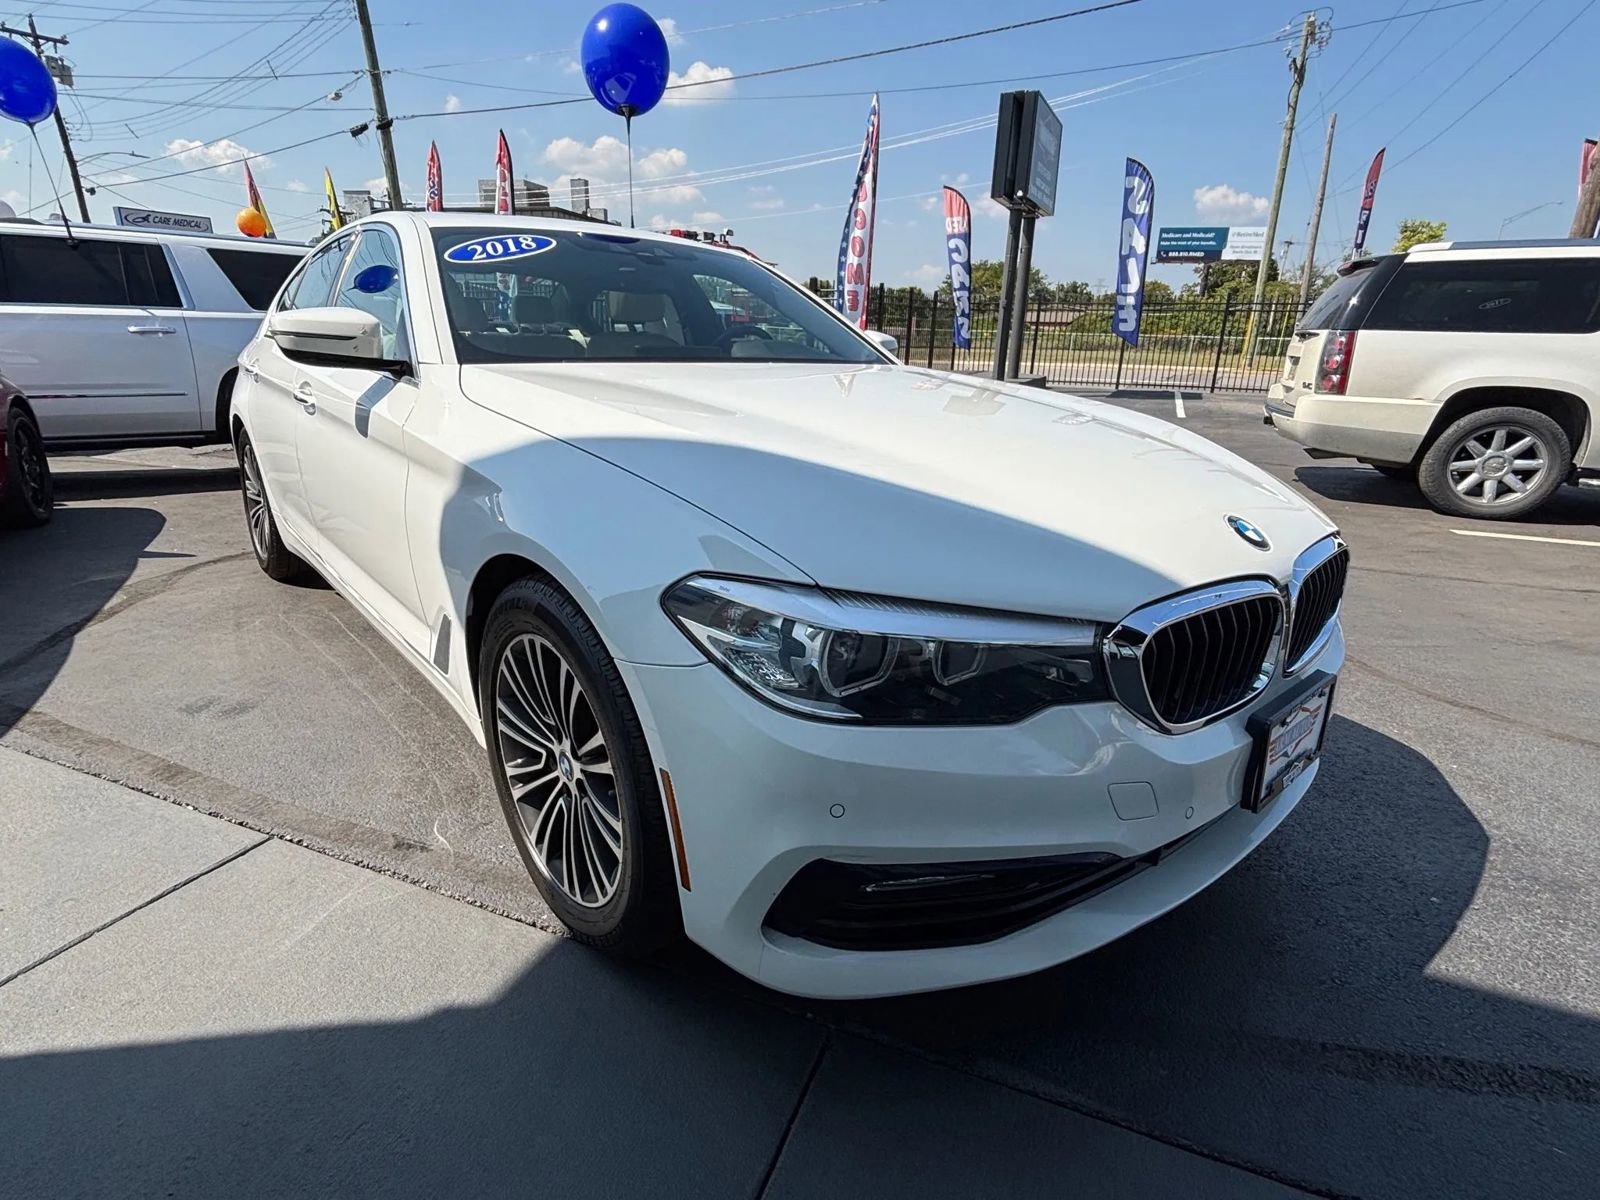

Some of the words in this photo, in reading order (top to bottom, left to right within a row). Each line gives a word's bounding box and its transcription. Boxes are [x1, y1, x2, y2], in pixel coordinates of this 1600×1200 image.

[152, 216, 171, 226] CARE
[171, 218, 202, 229] MEDICAL
[467, 235, 537, 260] 2018
